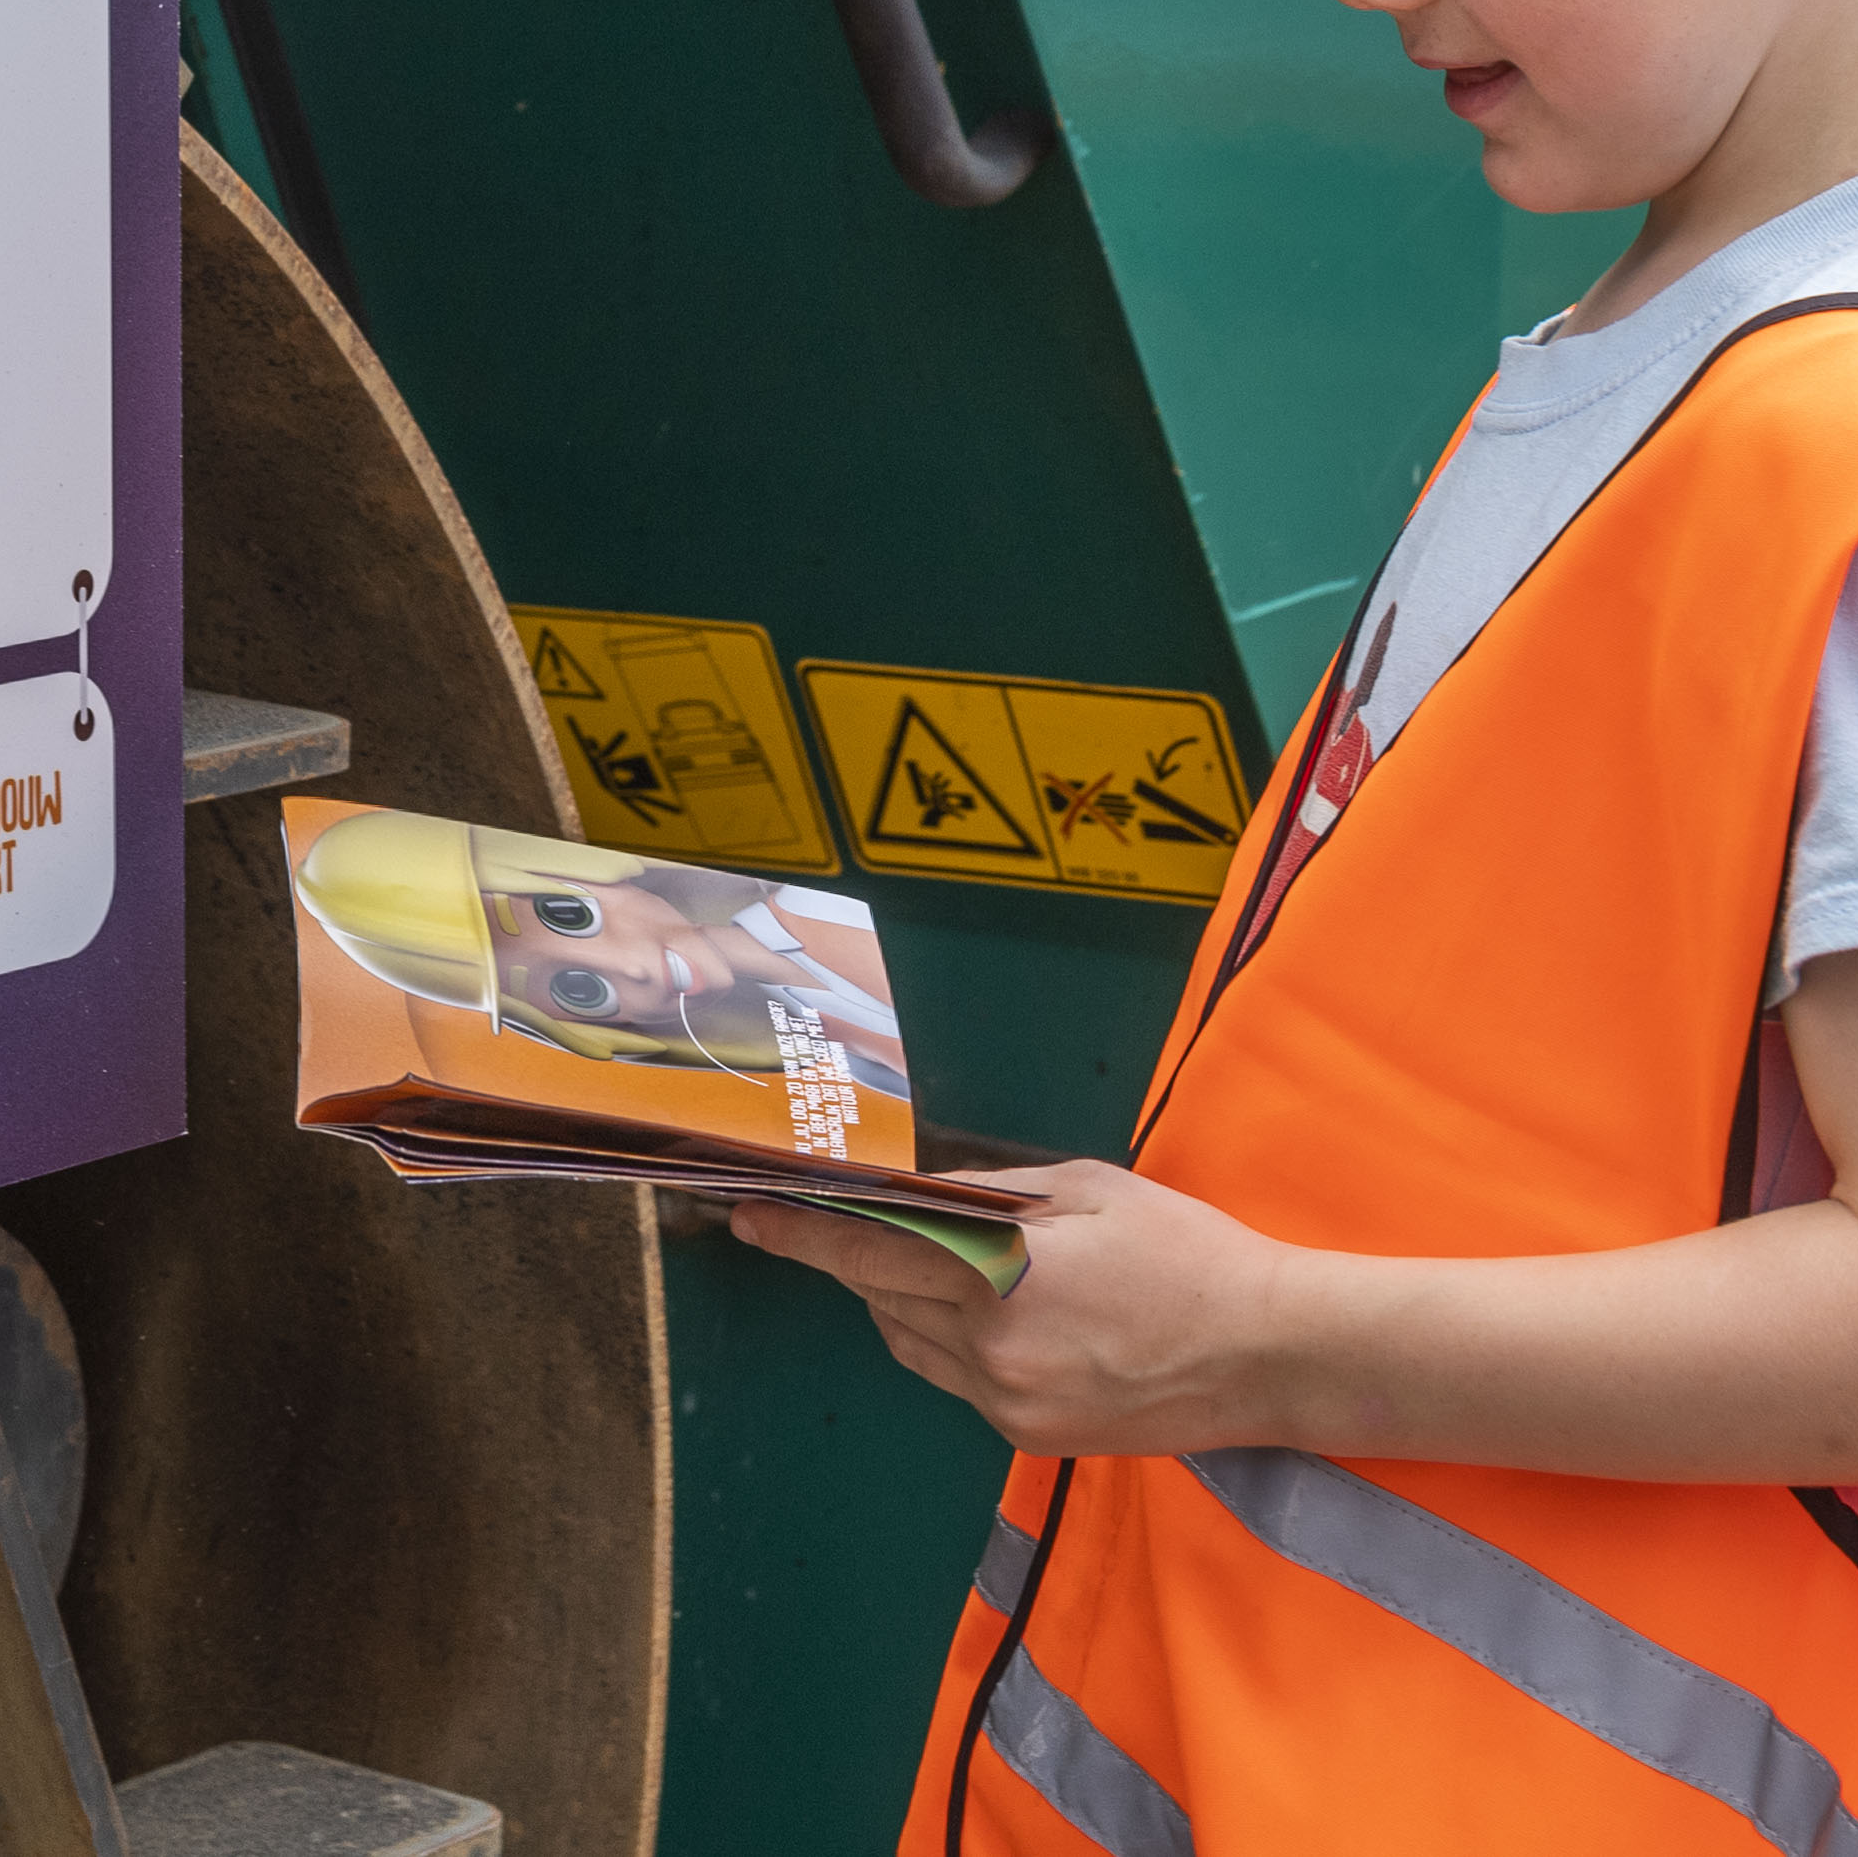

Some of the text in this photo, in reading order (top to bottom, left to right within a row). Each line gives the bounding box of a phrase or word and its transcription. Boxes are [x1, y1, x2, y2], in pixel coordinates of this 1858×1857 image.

[782, 1058, 802, 1079] VAN
[785, 1080, 805, 1095] ZO
[789, 1098, 808, 1120] OOK
[808, 1113, 828, 1133] BEN
[812, 1135, 829, 1148] IK
